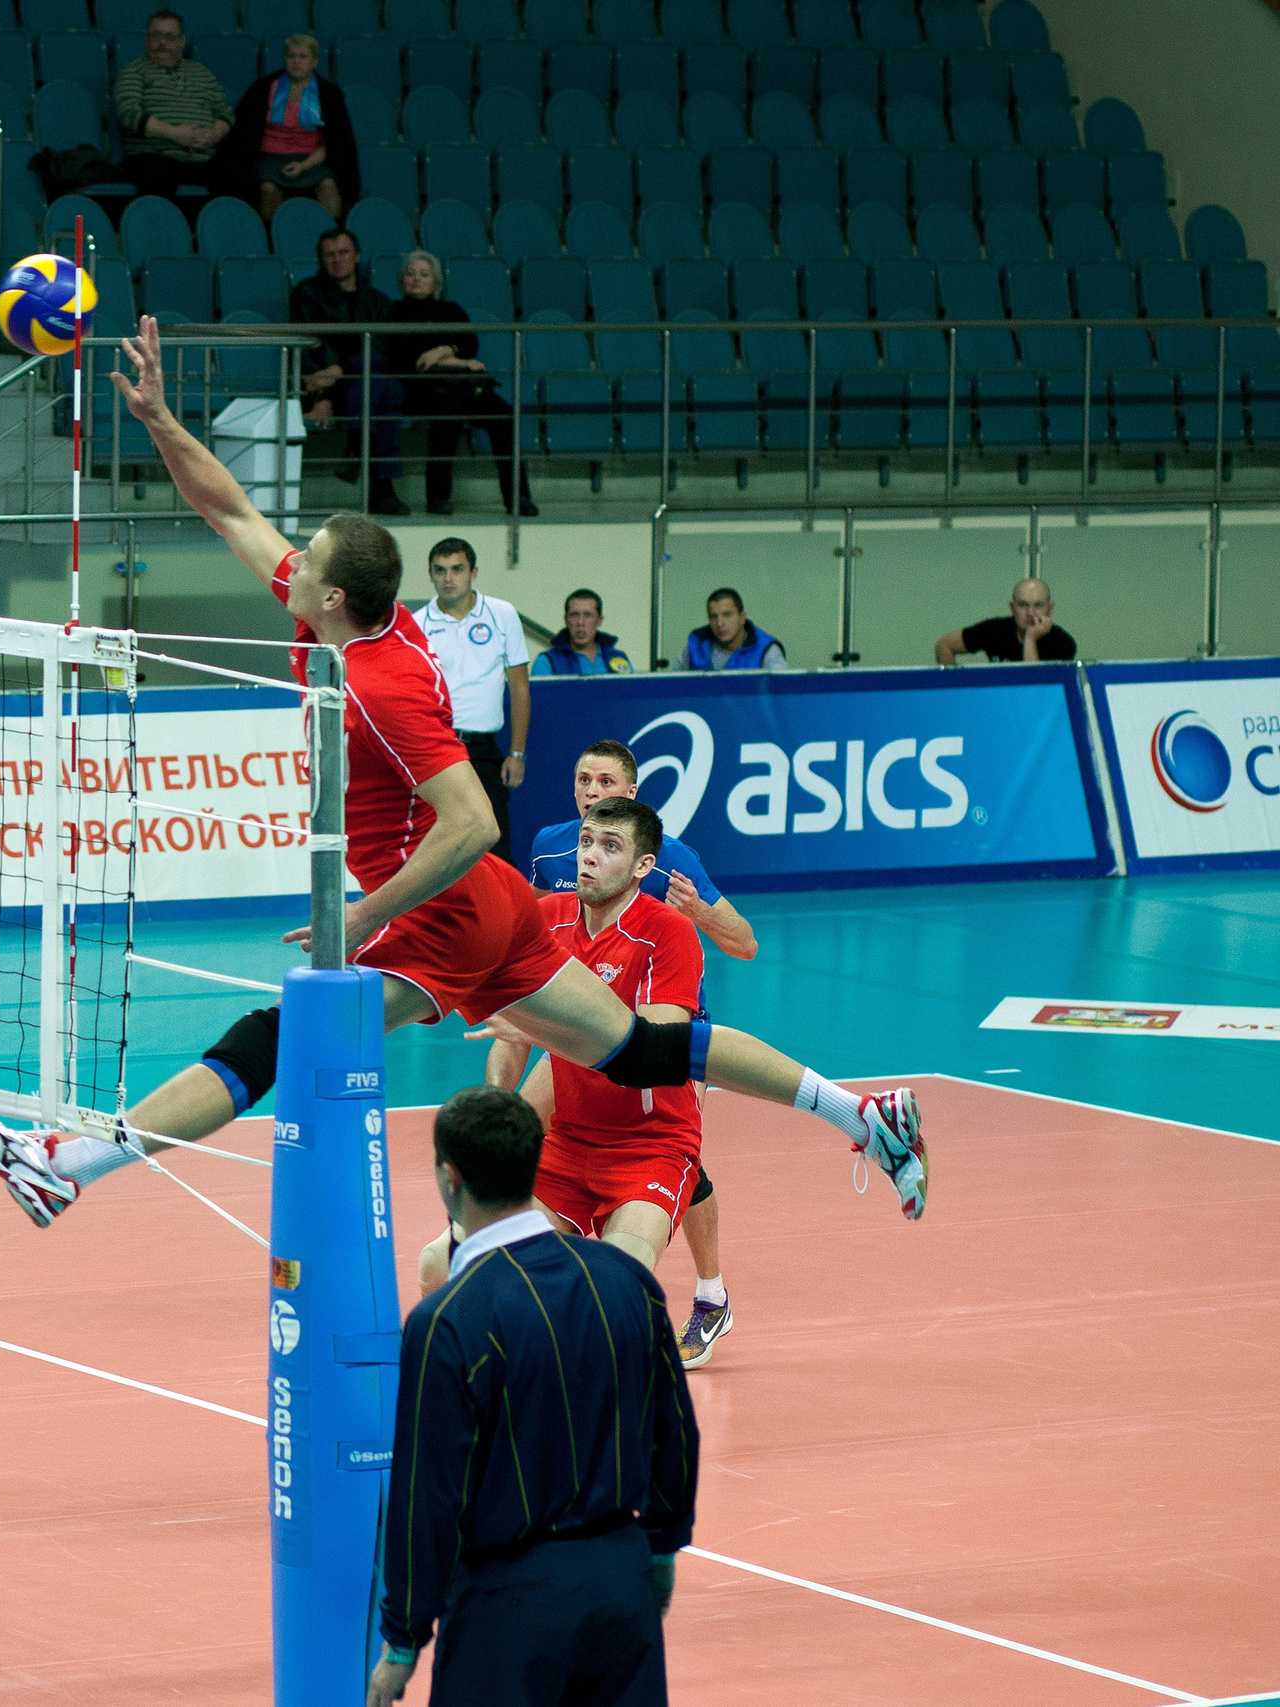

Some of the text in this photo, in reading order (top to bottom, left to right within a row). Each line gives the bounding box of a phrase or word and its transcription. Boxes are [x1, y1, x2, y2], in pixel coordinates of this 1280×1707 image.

[726, 736, 969, 836] asics
[1245, 745, 1280, 796] С
[368, 1139, 388, 1239] Senoh
[273, 1376, 292, 1521] Senoh
